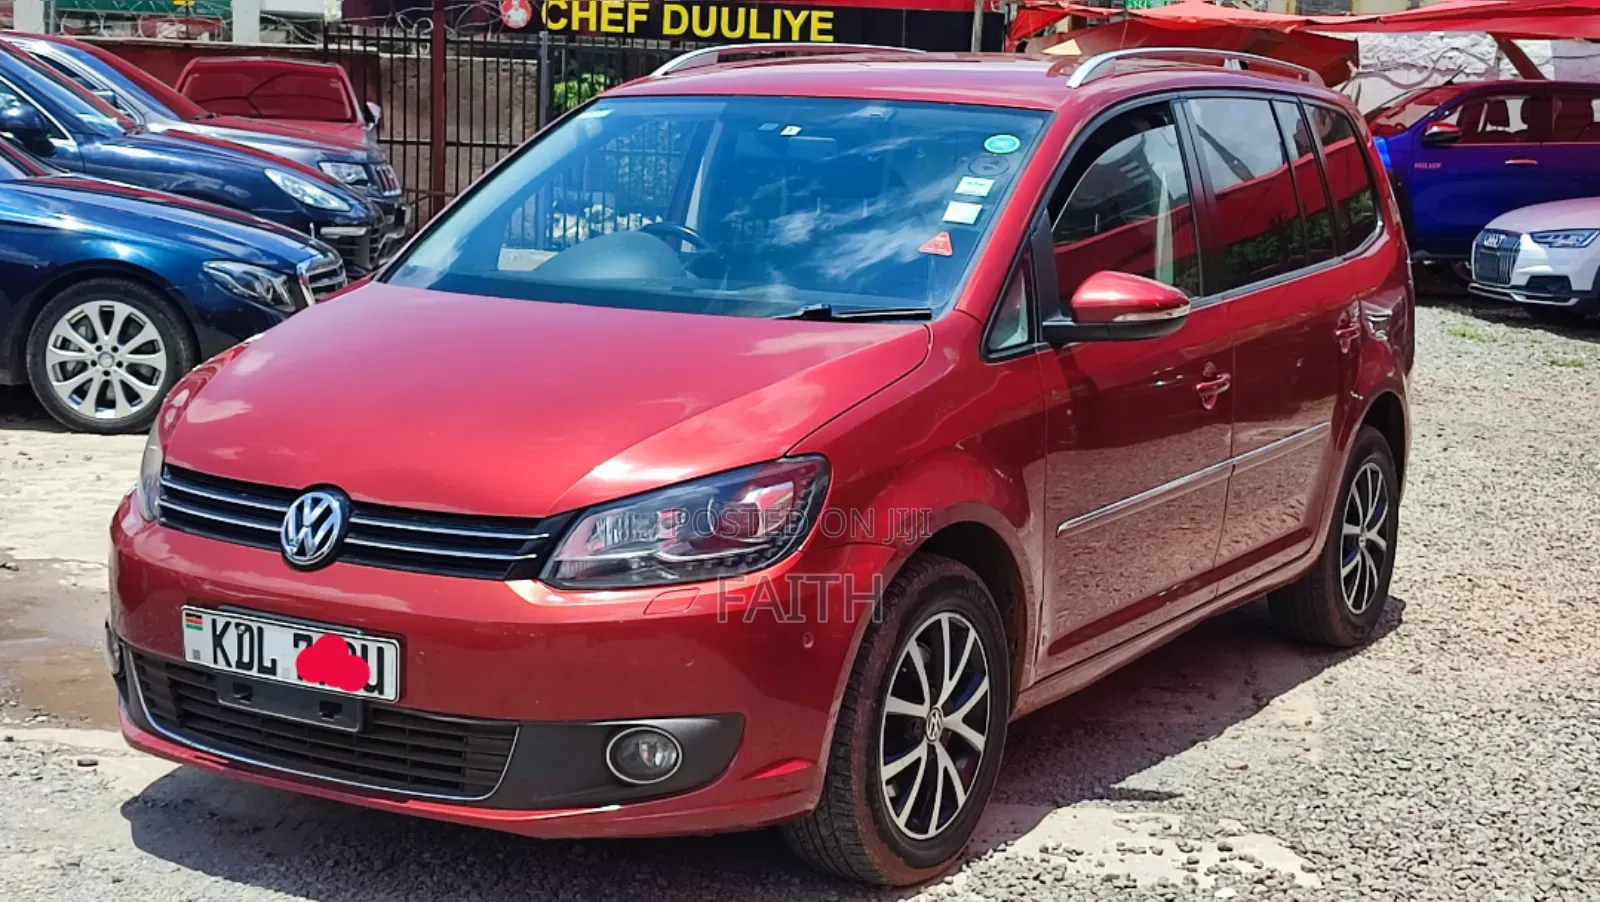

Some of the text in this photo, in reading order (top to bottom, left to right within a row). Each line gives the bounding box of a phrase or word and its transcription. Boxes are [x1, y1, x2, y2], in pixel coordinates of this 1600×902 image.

[541, 0, 834, 42] CHEF DUULIYE
[211, 618, 277, 677] KDL
